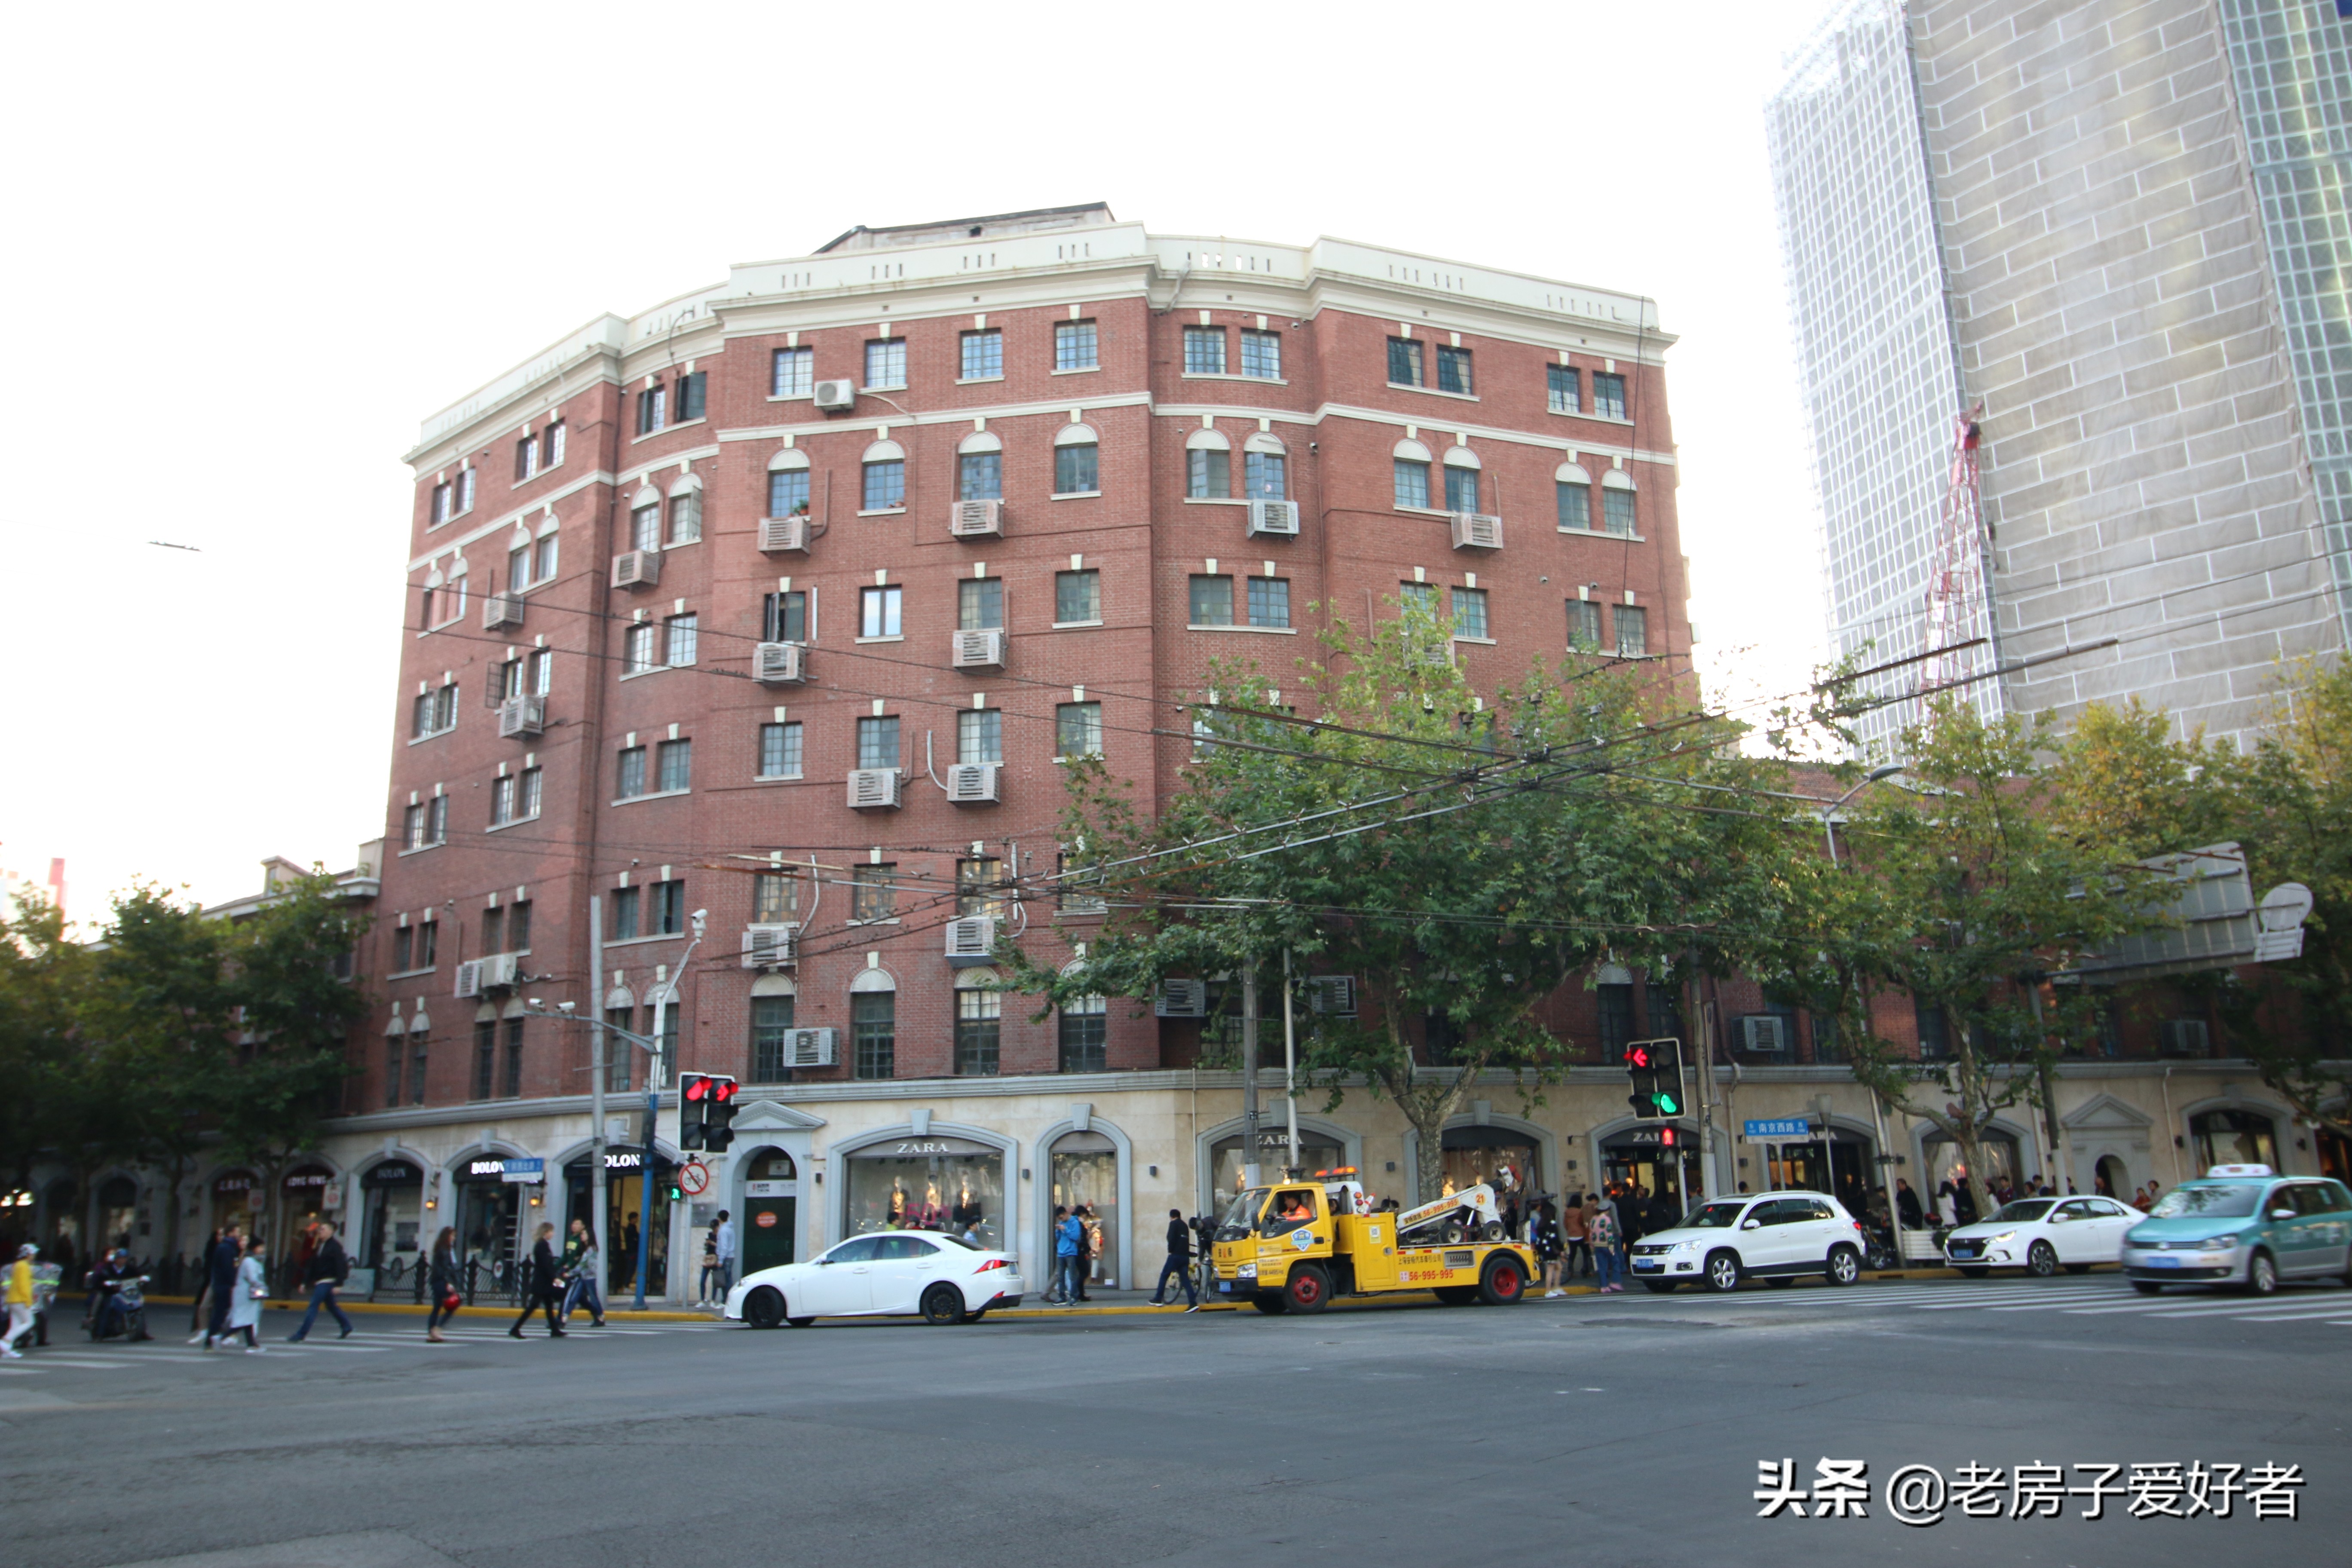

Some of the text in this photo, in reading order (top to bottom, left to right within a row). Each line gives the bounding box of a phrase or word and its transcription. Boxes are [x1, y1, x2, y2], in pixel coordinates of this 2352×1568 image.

[1759, 1122, 1795, 1133] 南京西路
[1633, 1133, 1659, 1142] ZA
[897, 1143, 949, 1153] ZARA
[604, 1154, 640, 1167] OLON
[1476, 1194, 1484, 1203] 21
[1423, 1198, 1458, 1216] 56-995-995
[1409, 1270, 1453, 1280] 56-995-995
